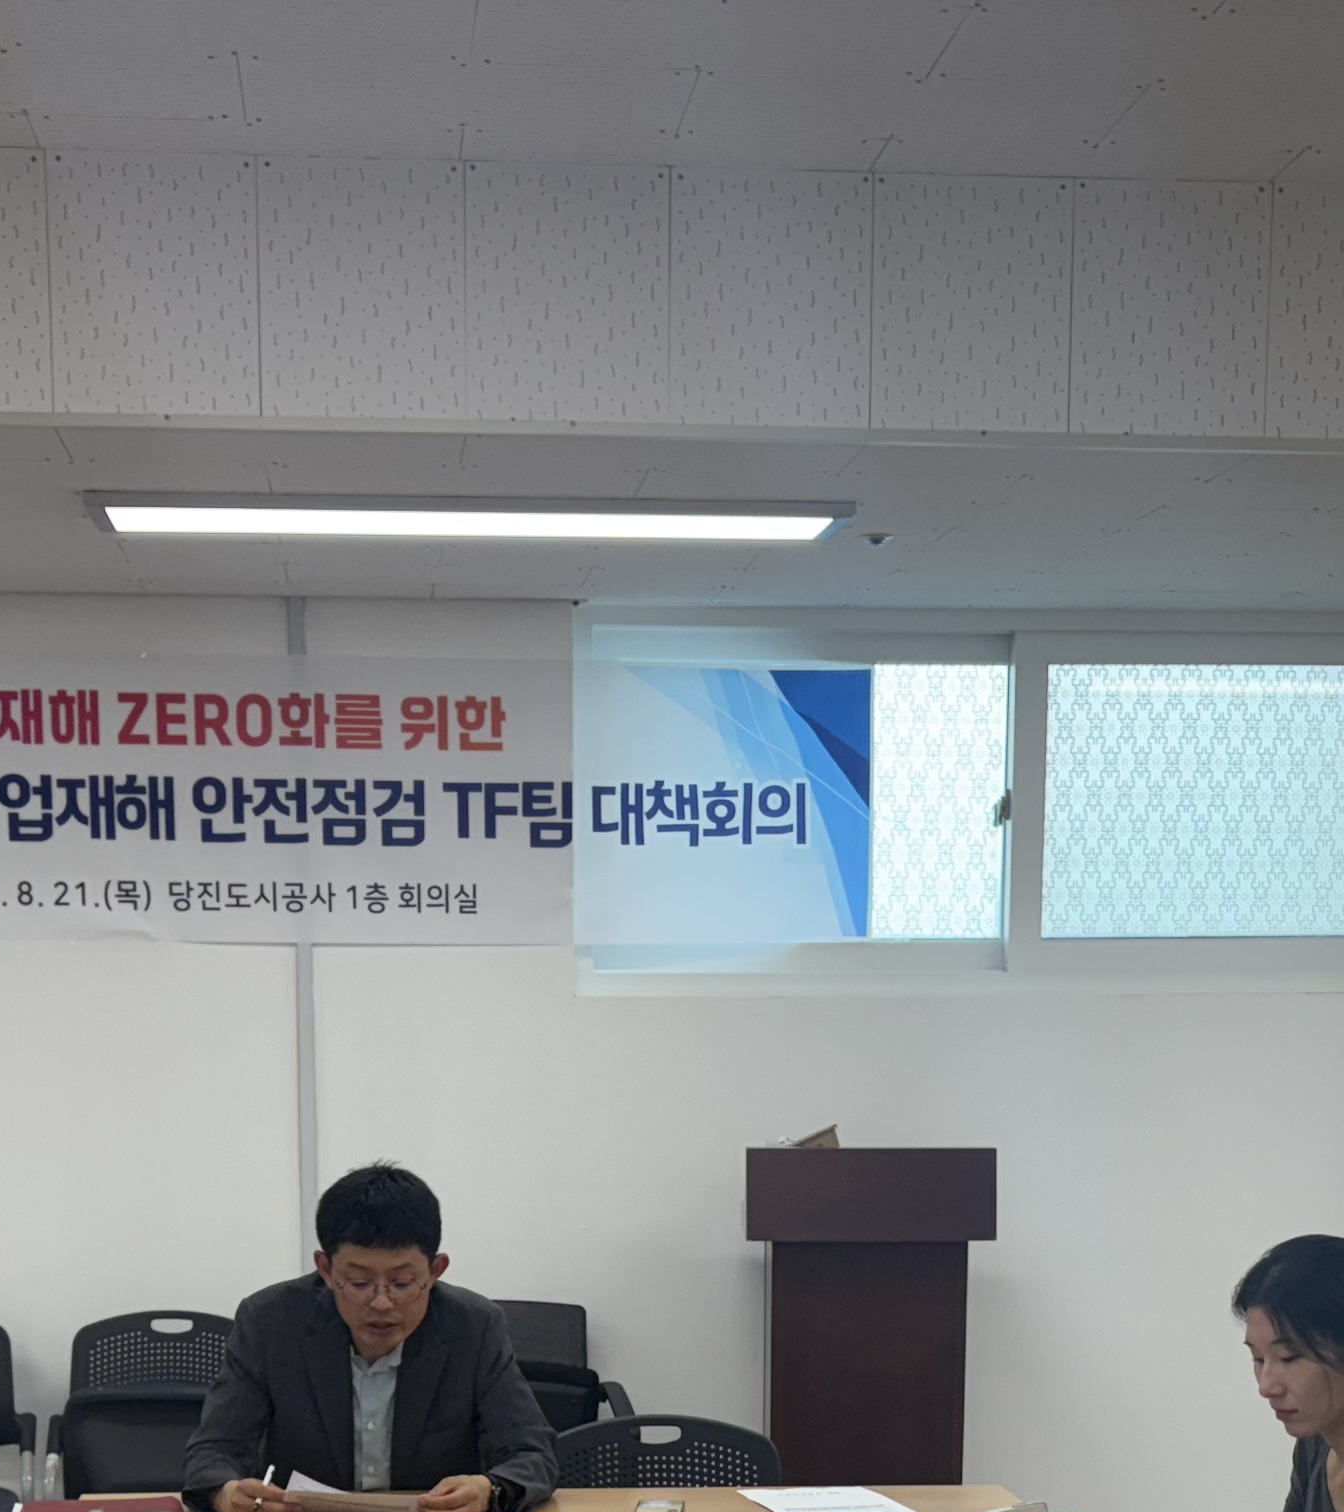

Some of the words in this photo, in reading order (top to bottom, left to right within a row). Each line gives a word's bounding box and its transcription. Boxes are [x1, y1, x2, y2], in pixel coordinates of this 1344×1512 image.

[117, 691, 384, 749] ZERO화를
[400, 695, 506, 752] 위한
[192, 776, 425, 847] 안전점검
[442, 780, 574, 849] TF팀
[591, 780, 808, 847] 대책회의
[168, 880, 336, 914] 당진도시공사
[346, 882, 389, 914] 1층
[398, 882, 478, 915] 회의실
